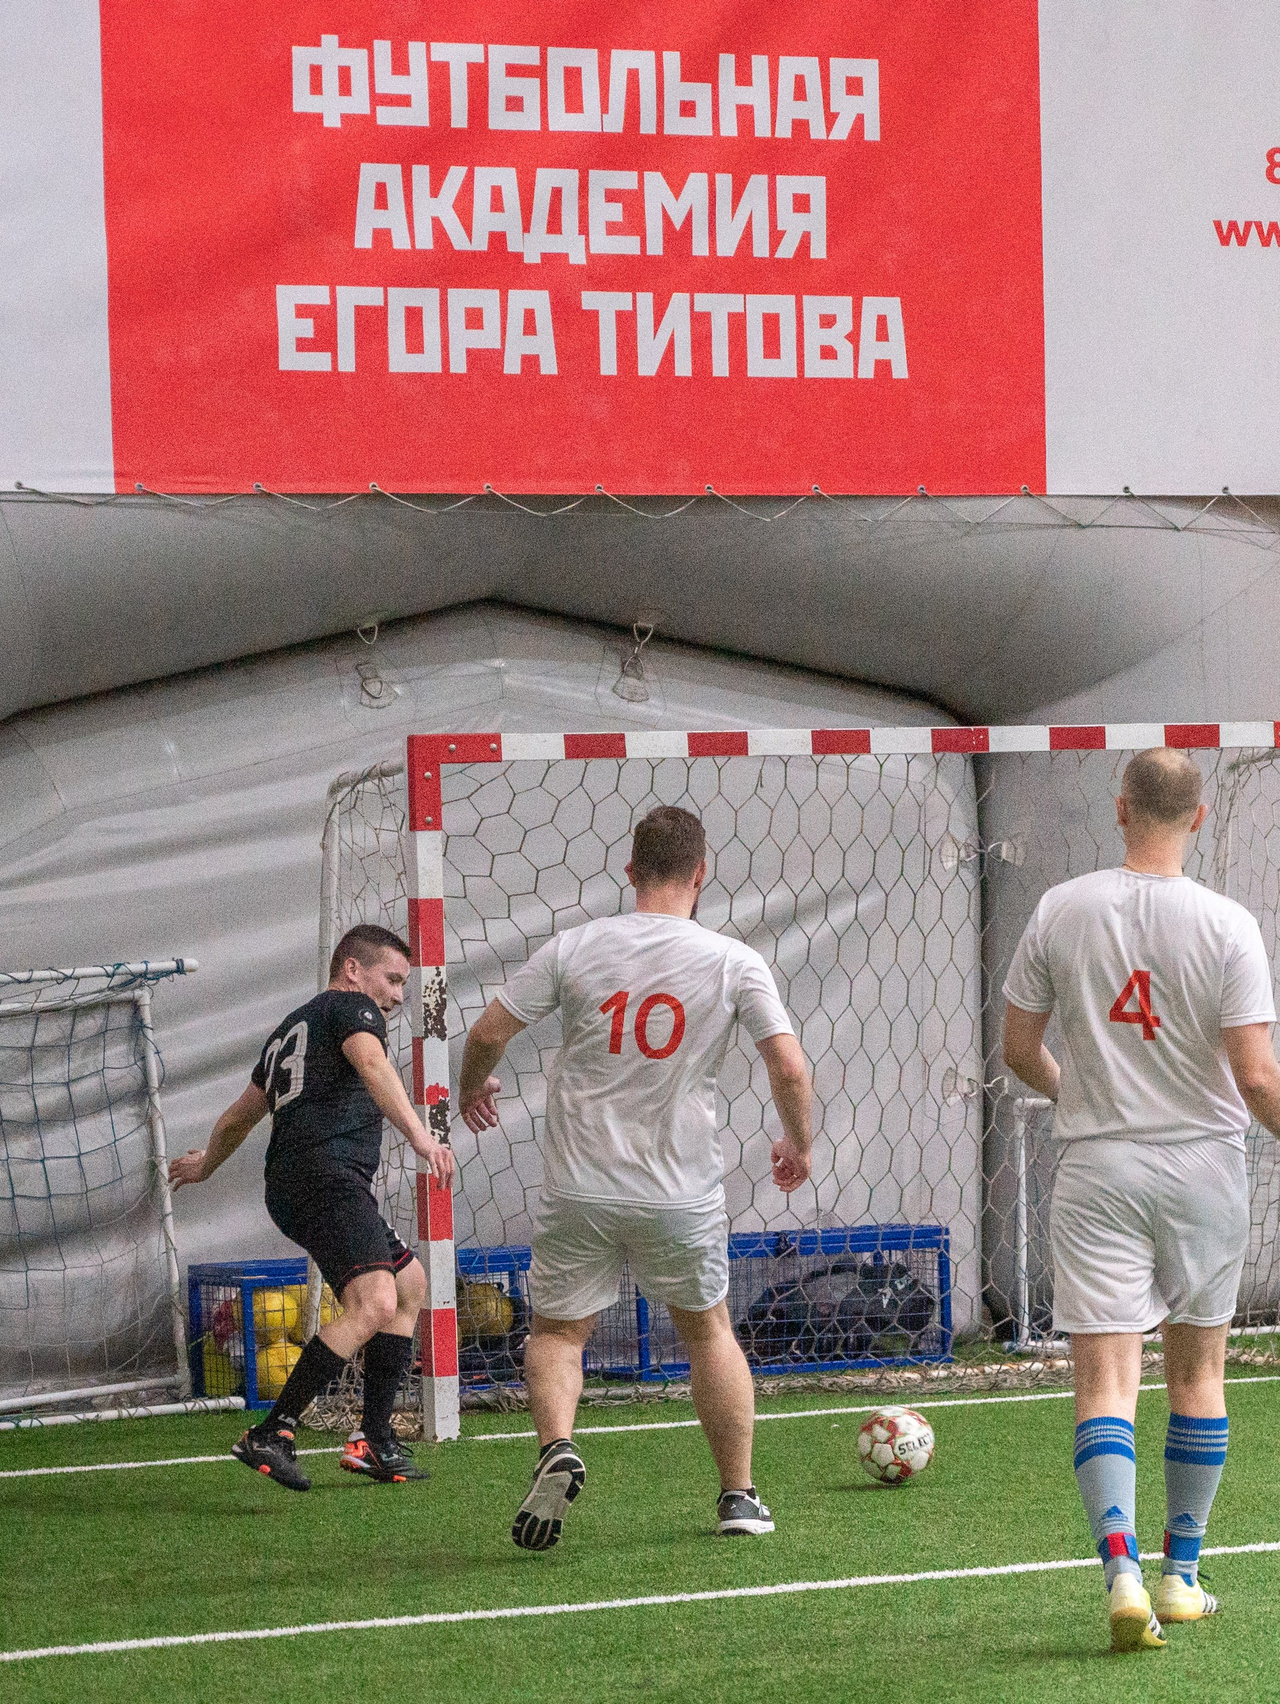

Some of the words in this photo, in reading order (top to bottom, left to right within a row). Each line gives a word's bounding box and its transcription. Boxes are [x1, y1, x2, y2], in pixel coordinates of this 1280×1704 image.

[291, 34, 881, 141] ФУТБОЛЬНАЯ
[353, 162, 827, 265] АКАДЕМИЯ
[275, 284, 559, 376] ЕГОРА
[581, 291, 909, 379] ТИТОВА
[599, 991, 686, 1060] 10
[1109, 969, 1162, 1041] 4
